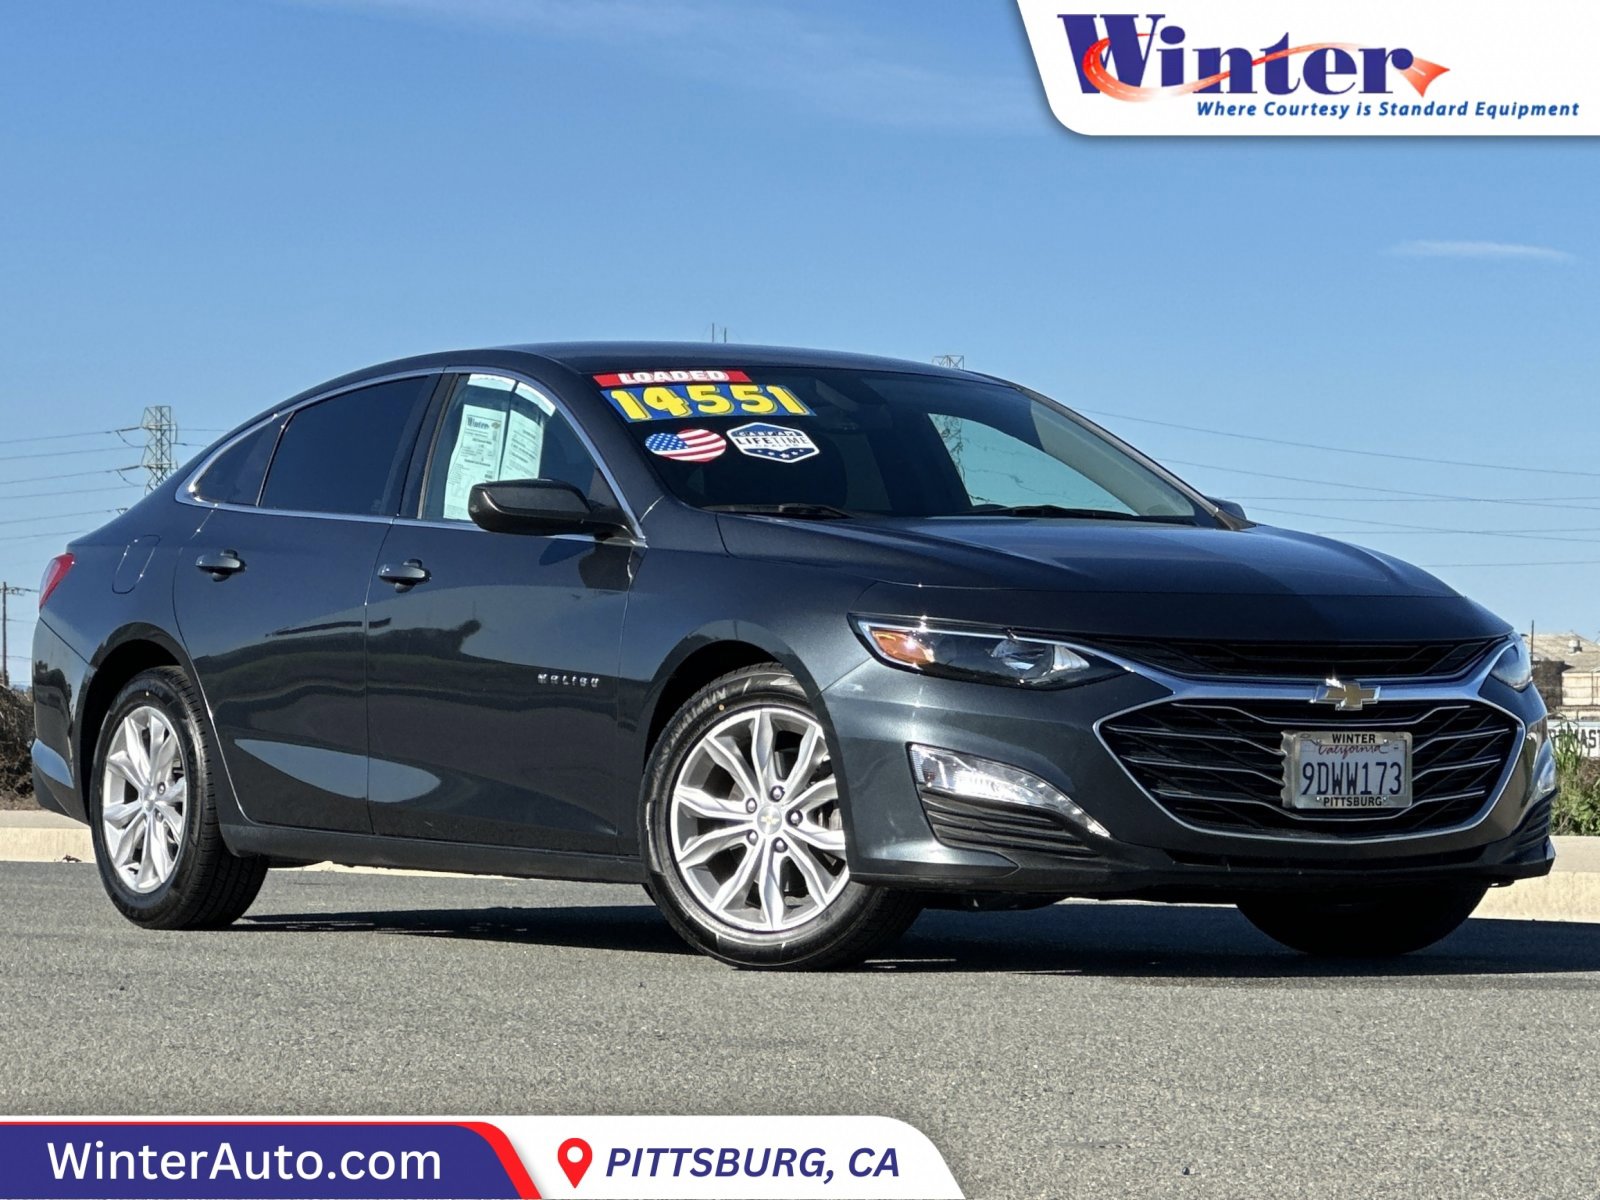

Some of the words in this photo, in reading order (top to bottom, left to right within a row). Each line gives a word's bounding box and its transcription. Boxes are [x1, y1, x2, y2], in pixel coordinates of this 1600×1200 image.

[618, 370, 730, 385] LOADED
[610, 385, 810, 420] 14551
[735, 437, 811, 445] LIFETIME
[1332, 733, 1376, 744] WINTER
[1318, 744, 1389, 760] California
[1301, 762, 1402, 795] 9DWW173
[1323, 796, 1383, 807] PITTSBURG
